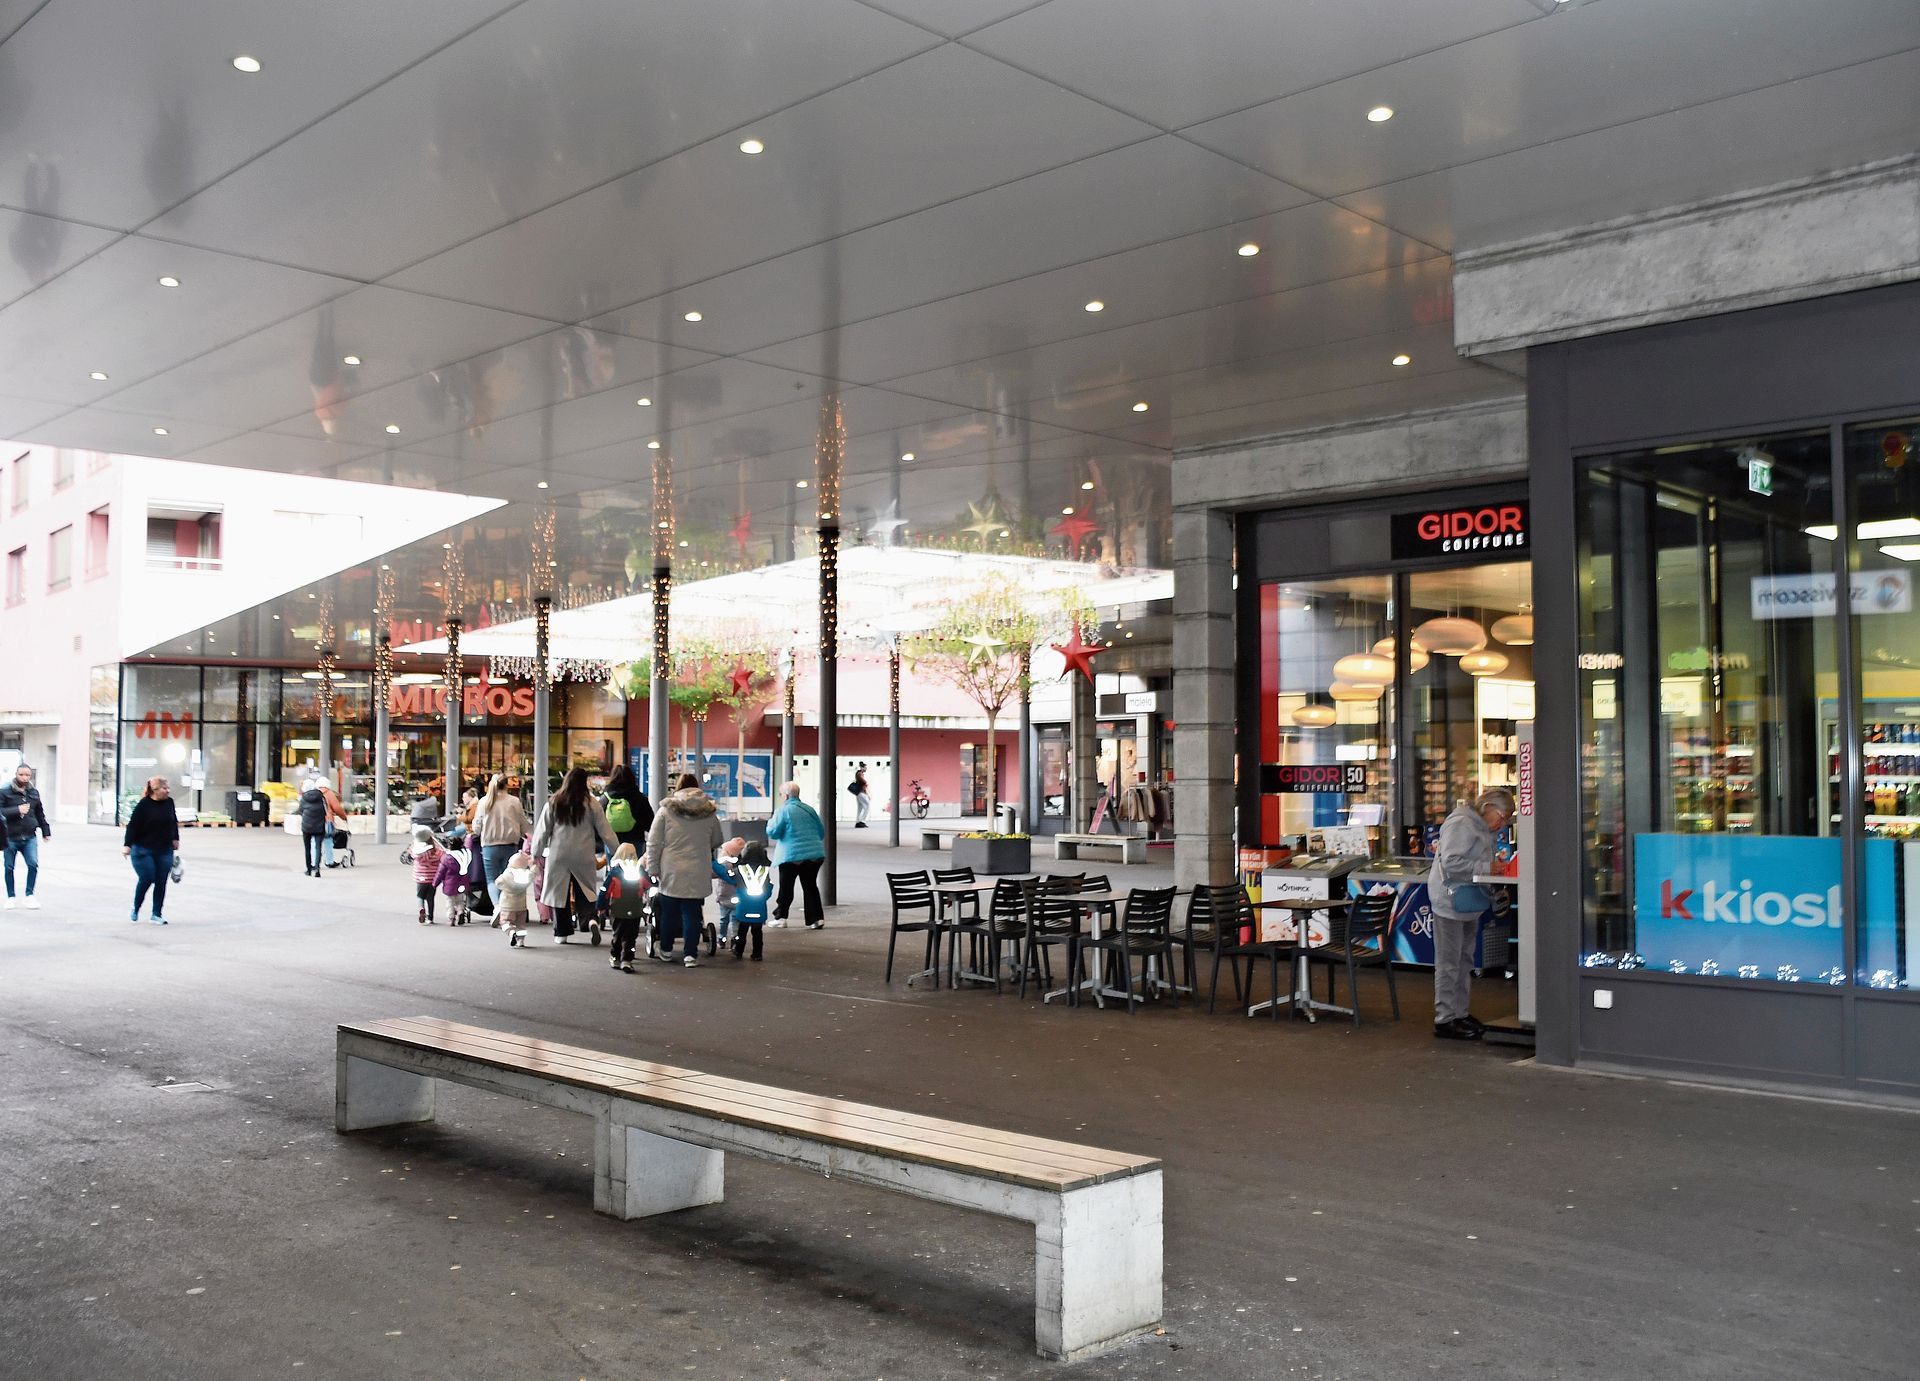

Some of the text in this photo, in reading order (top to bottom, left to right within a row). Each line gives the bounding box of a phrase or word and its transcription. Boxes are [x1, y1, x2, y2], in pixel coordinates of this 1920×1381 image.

[1417, 506, 1522, 540] GIDOR
[1442, 532, 1524, 552] COIFFURE
[1279, 766, 1364, 784] GIDOR 50
[1293, 784, 1341, 792] COIFFURE
[1661, 879, 1694, 920] k
